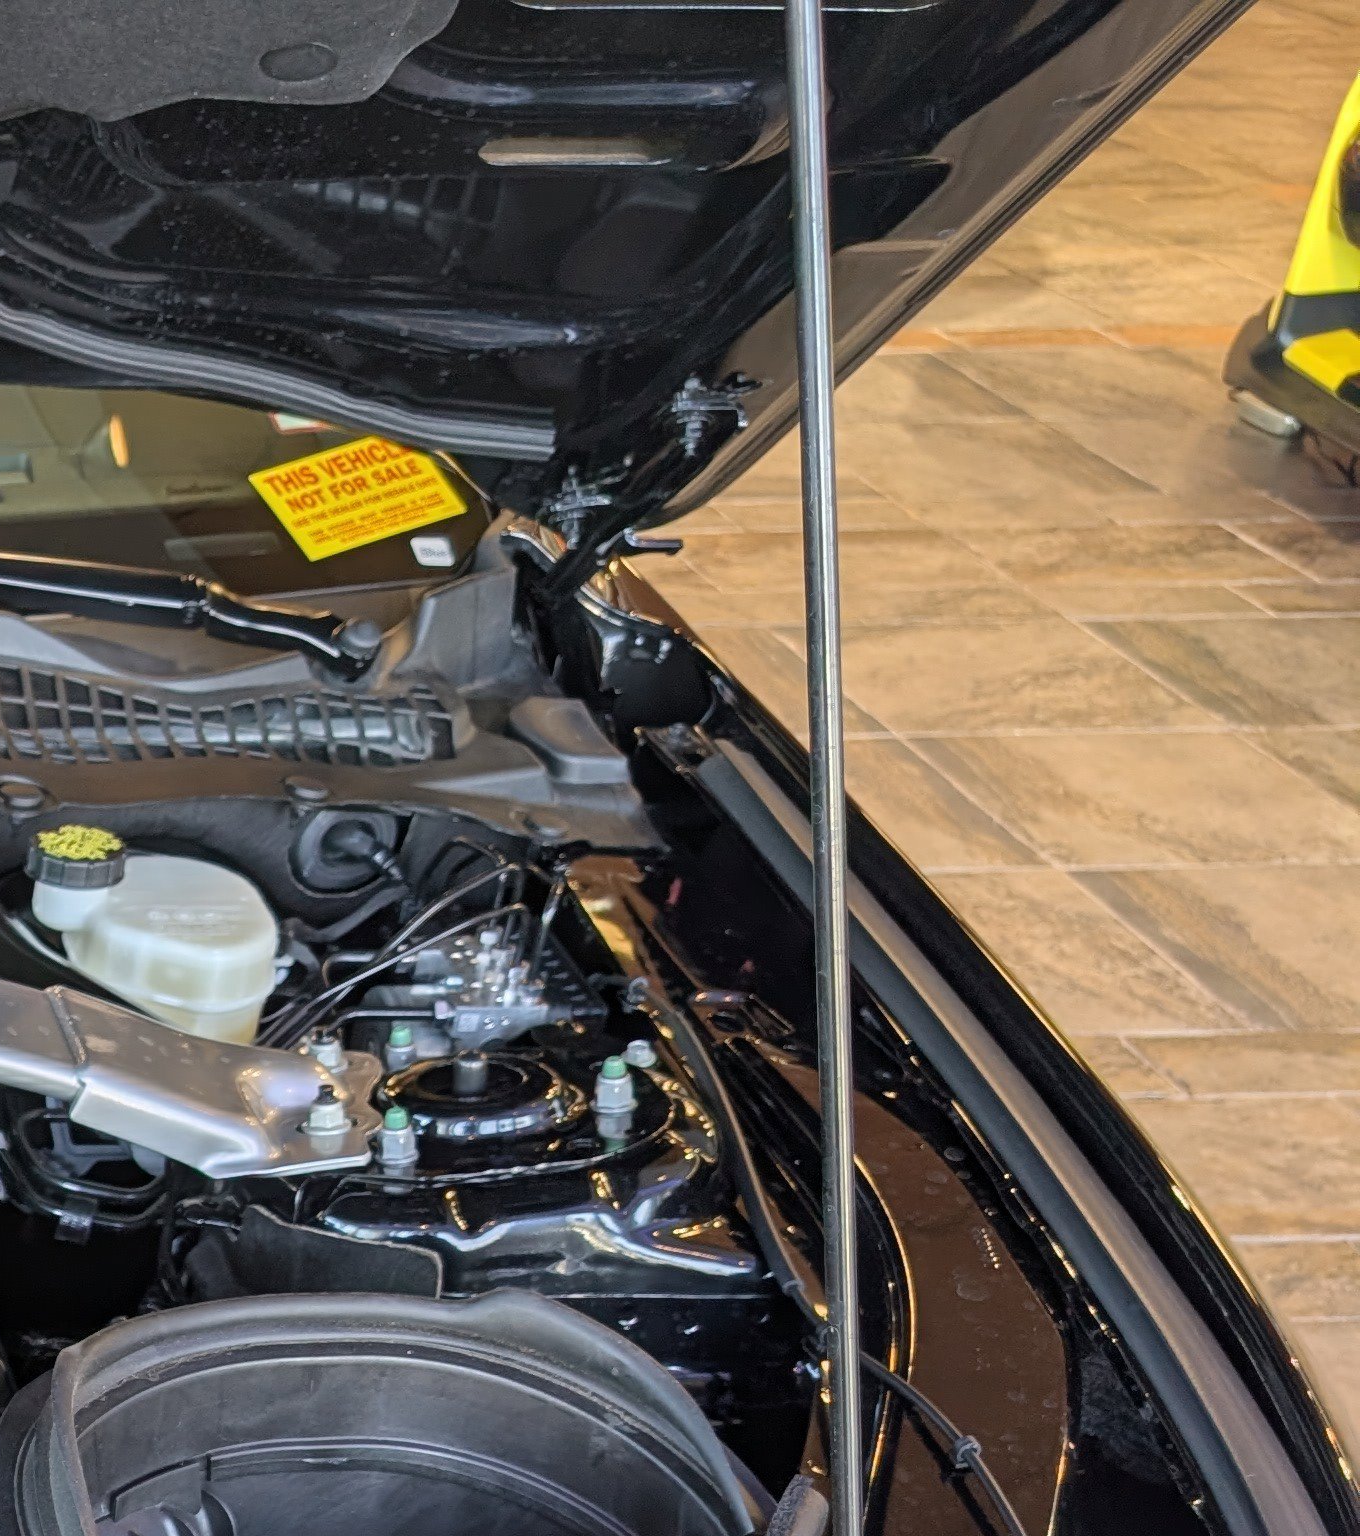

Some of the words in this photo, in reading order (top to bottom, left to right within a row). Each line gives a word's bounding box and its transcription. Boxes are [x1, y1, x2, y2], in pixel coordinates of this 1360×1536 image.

[261, 464, 321, 497] THIS
[283, 488, 329, 513] NOT
[326, 474, 372, 500] FOR
[369, 458, 423, 486] SALE
